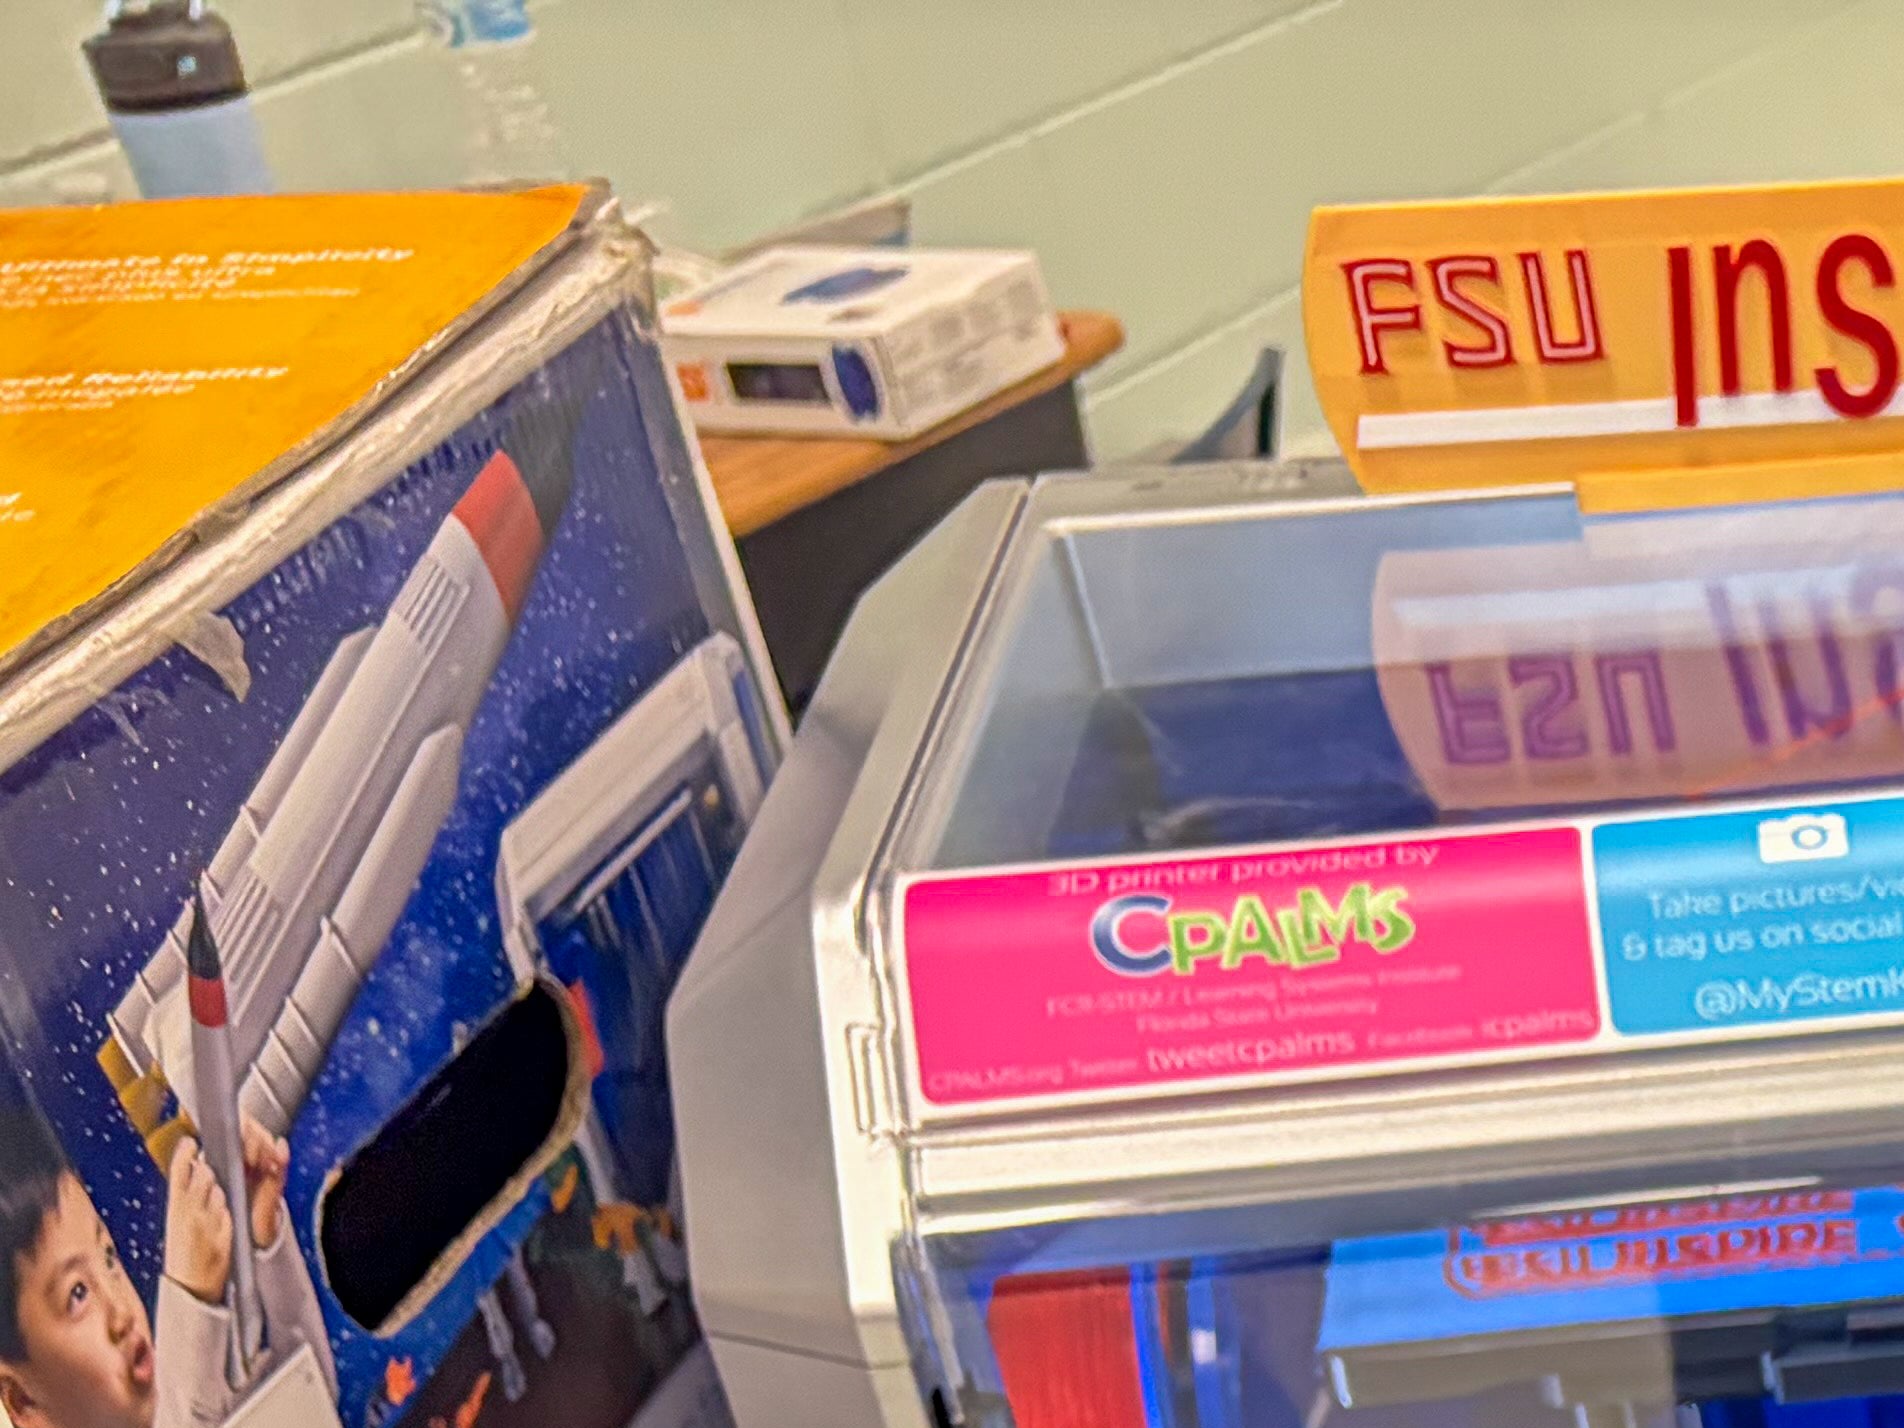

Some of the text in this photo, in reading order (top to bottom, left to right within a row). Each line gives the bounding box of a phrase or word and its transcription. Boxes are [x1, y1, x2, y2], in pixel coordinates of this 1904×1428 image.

[221, 249, 413, 266] Simplicity
[1340, 248, 1607, 375] FSU
[1049, 845, 1440, 895] 3D printer provided by
[1650, 890, 1722, 920] Take
[1091, 882, 1416, 977] CPALMS
[1622, 932, 1648, 961] &
[1655, 933, 1707, 960] tag
[1714, 930, 1753, 954] us
[1760, 925, 1802, 949] on
[1811, 913, 1904, 945] social
[1184, 980, 1276, 1006] Learning
[1146, 1030, 1355, 1073] tweetcpalms
